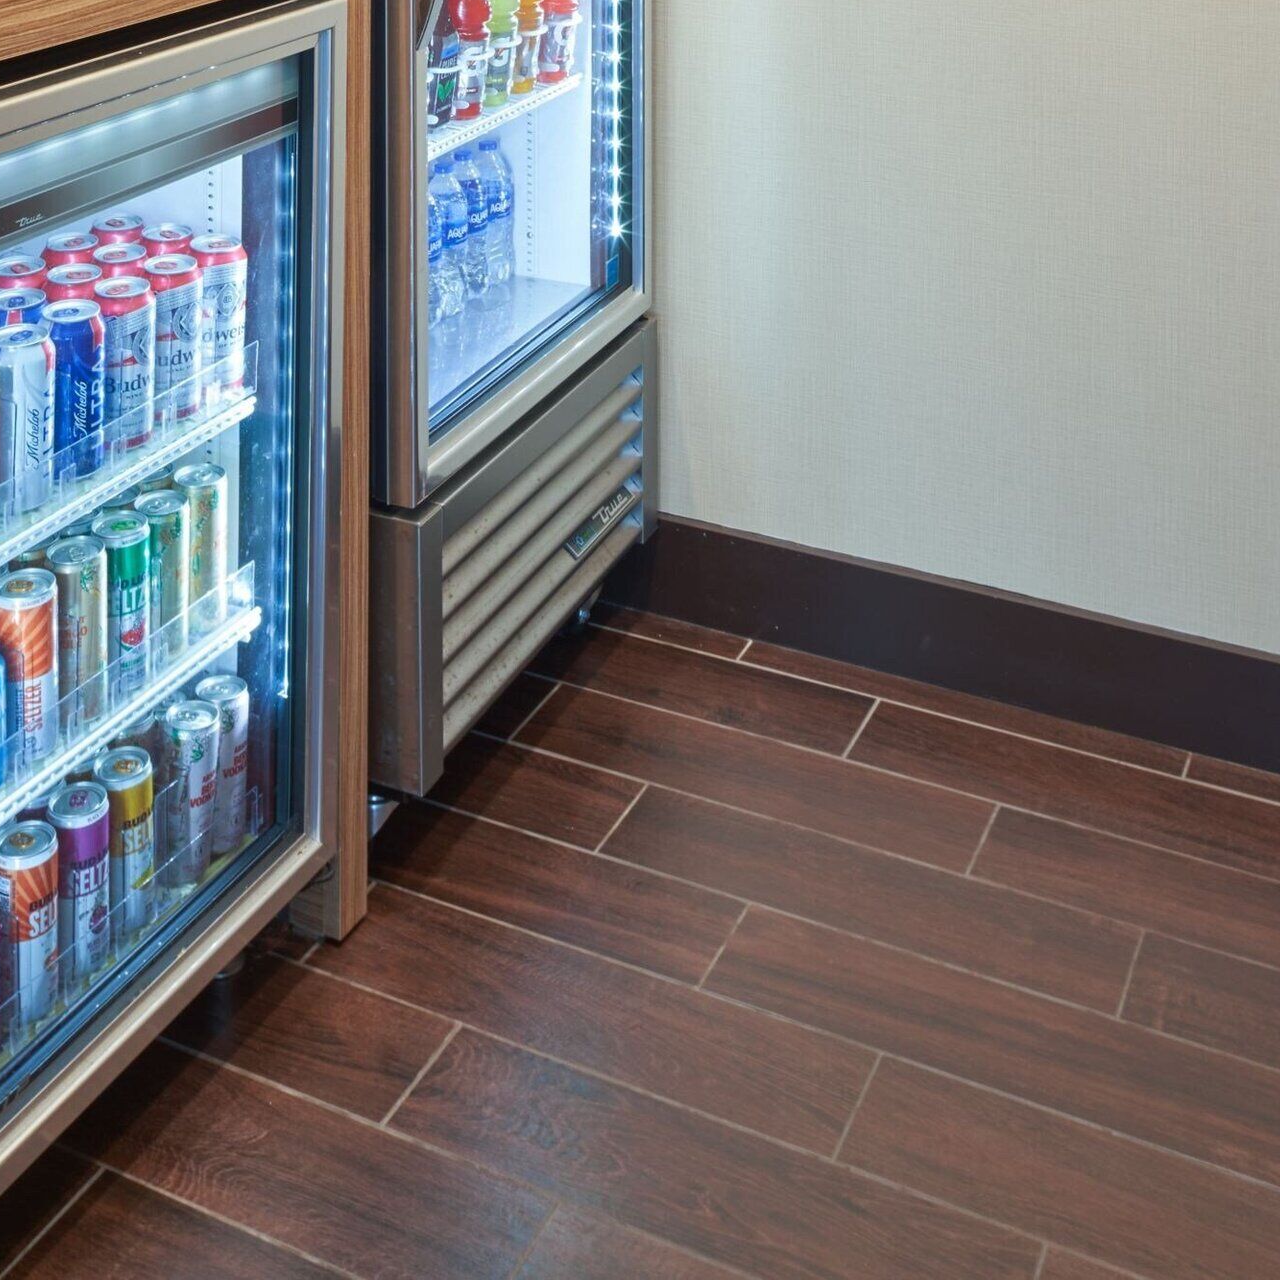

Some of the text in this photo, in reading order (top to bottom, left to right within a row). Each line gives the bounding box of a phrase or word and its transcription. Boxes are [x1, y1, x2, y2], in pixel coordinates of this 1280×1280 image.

[73, 380, 88, 438] Michelob
[26, 408, 40, 470] Michelob
[592, 493, 628, 525] True
[24, 684, 43, 733] SELTZER
